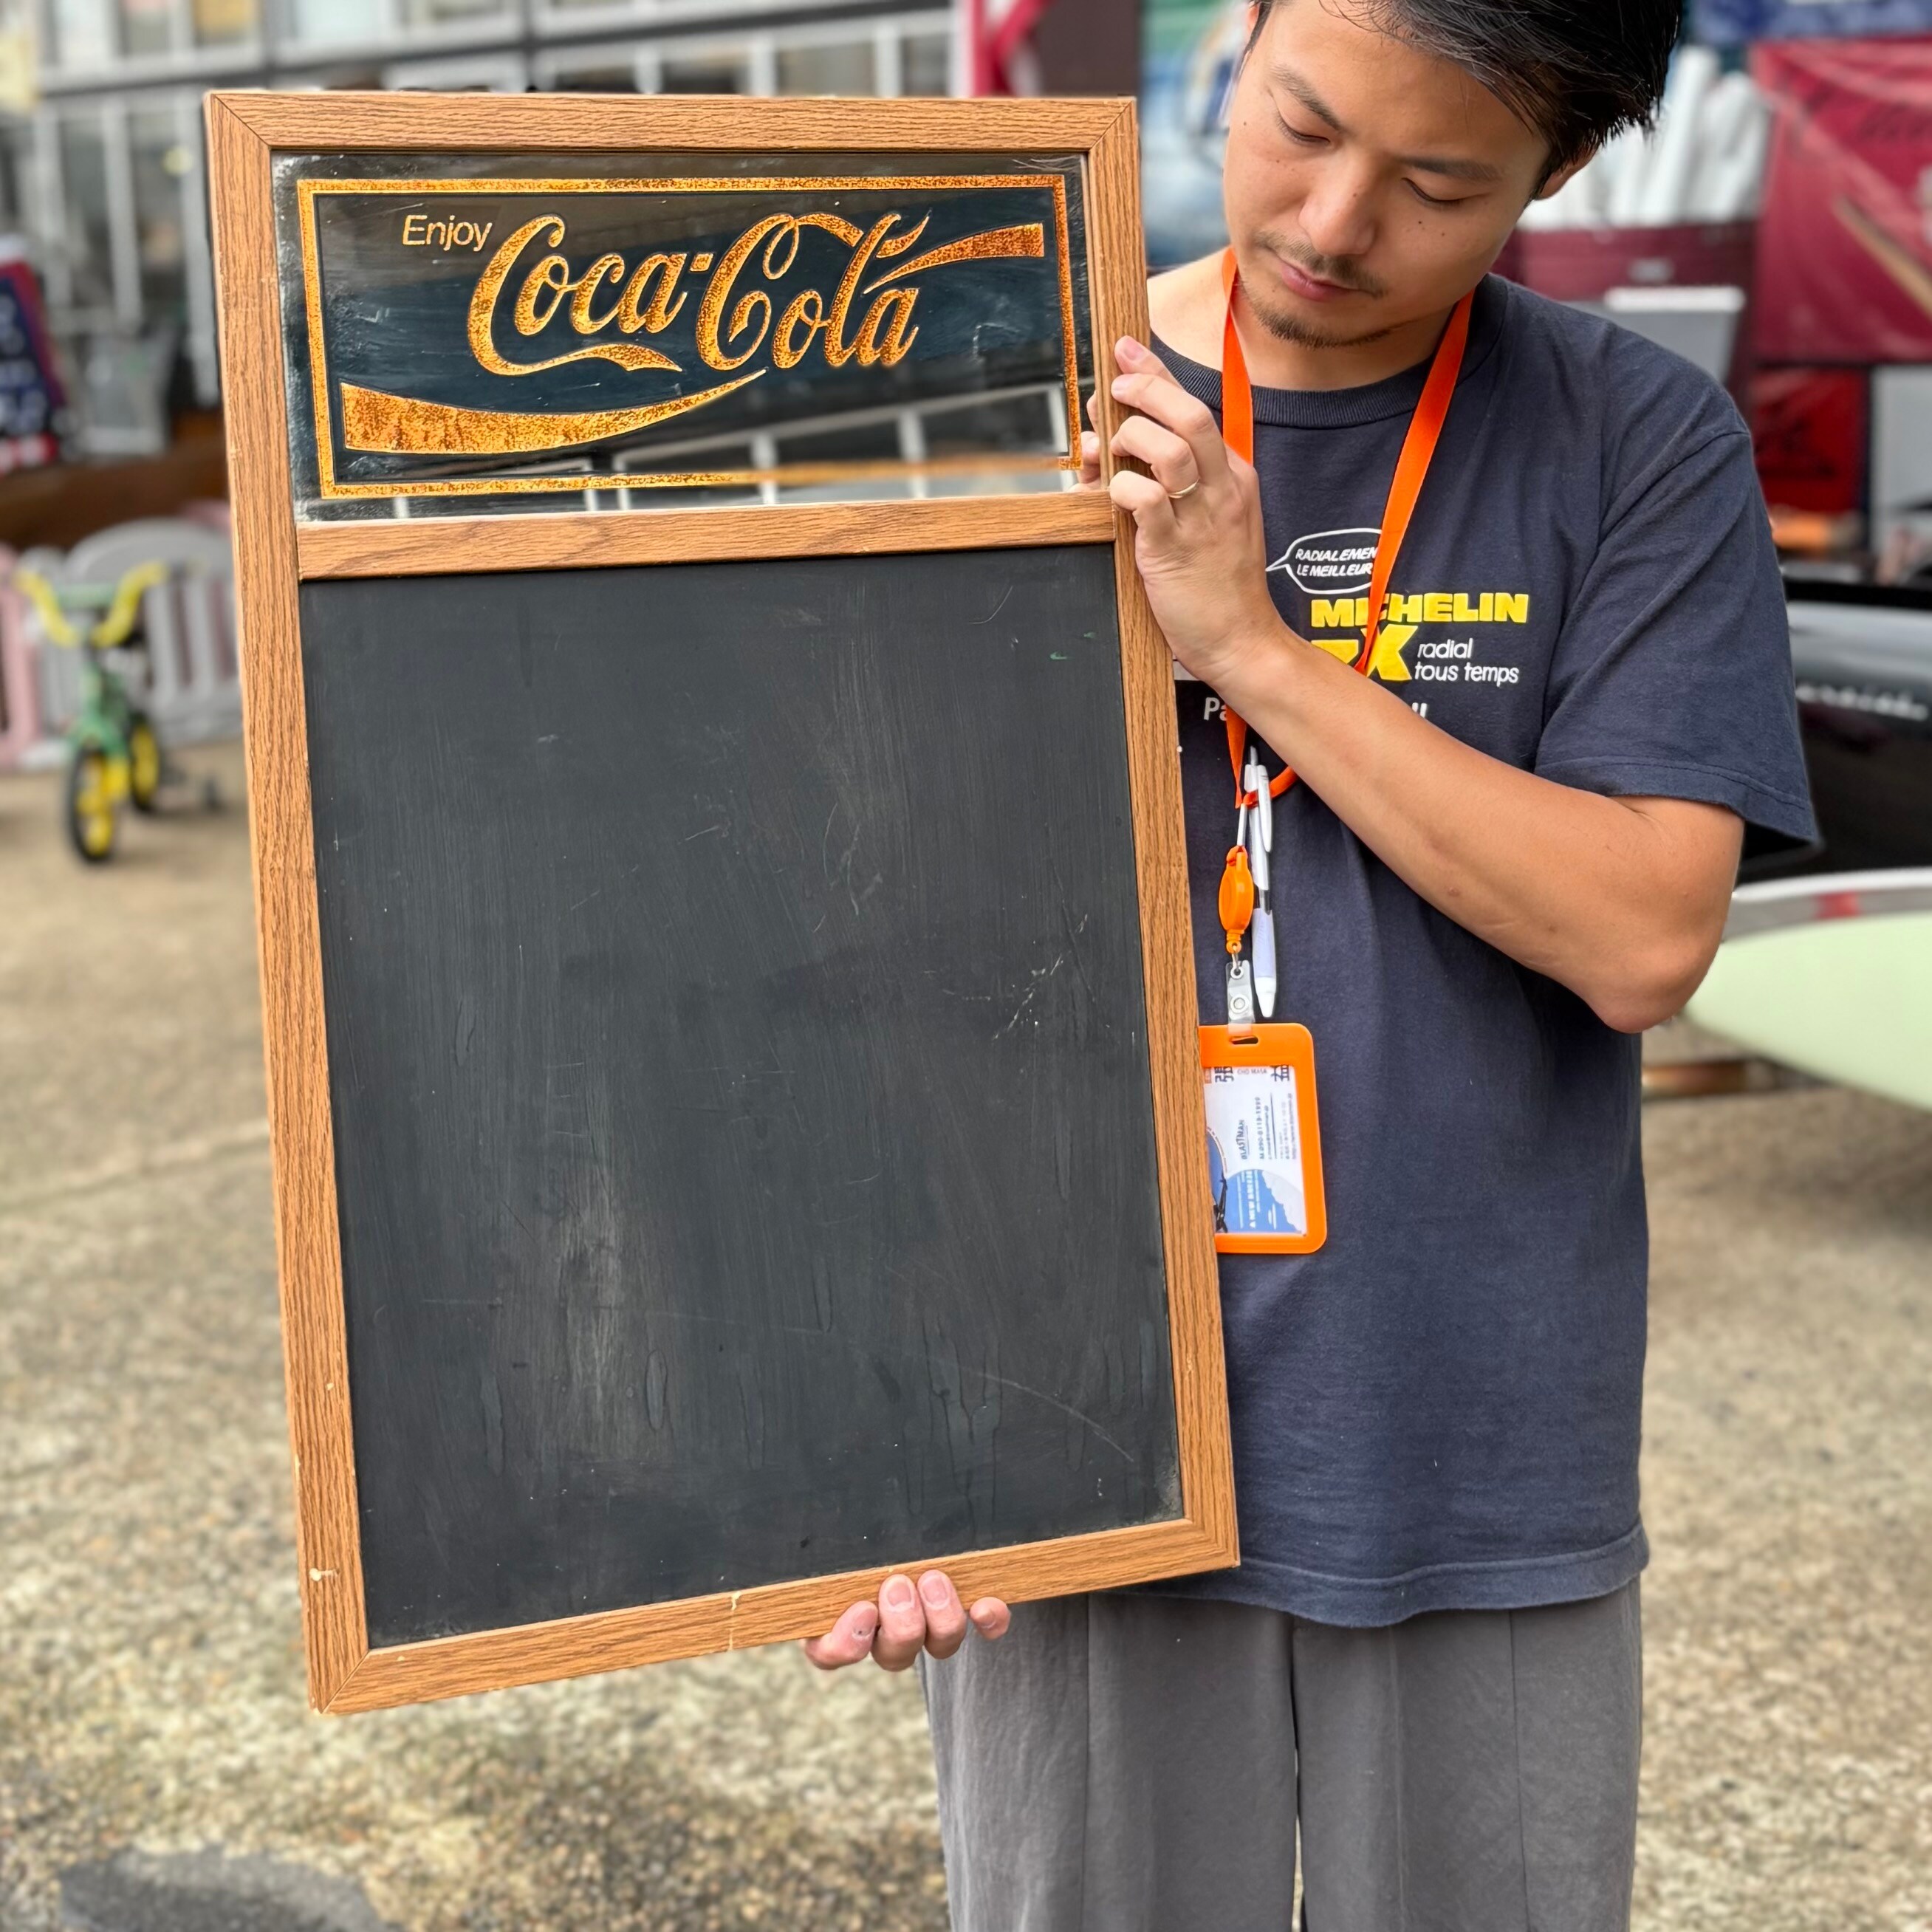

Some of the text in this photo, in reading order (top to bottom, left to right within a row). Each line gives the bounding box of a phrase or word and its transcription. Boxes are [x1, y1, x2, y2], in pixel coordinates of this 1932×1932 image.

[402, 210, 931, 375] Enjoy Coca-Cola
[1295, 547, 1377, 563] RADIALEMEN
[1296, 563, 1374, 577] LE MEILLEUR
[1417, 638, 1473, 659] radial
[1414, 662, 1519, 688] tous temps
